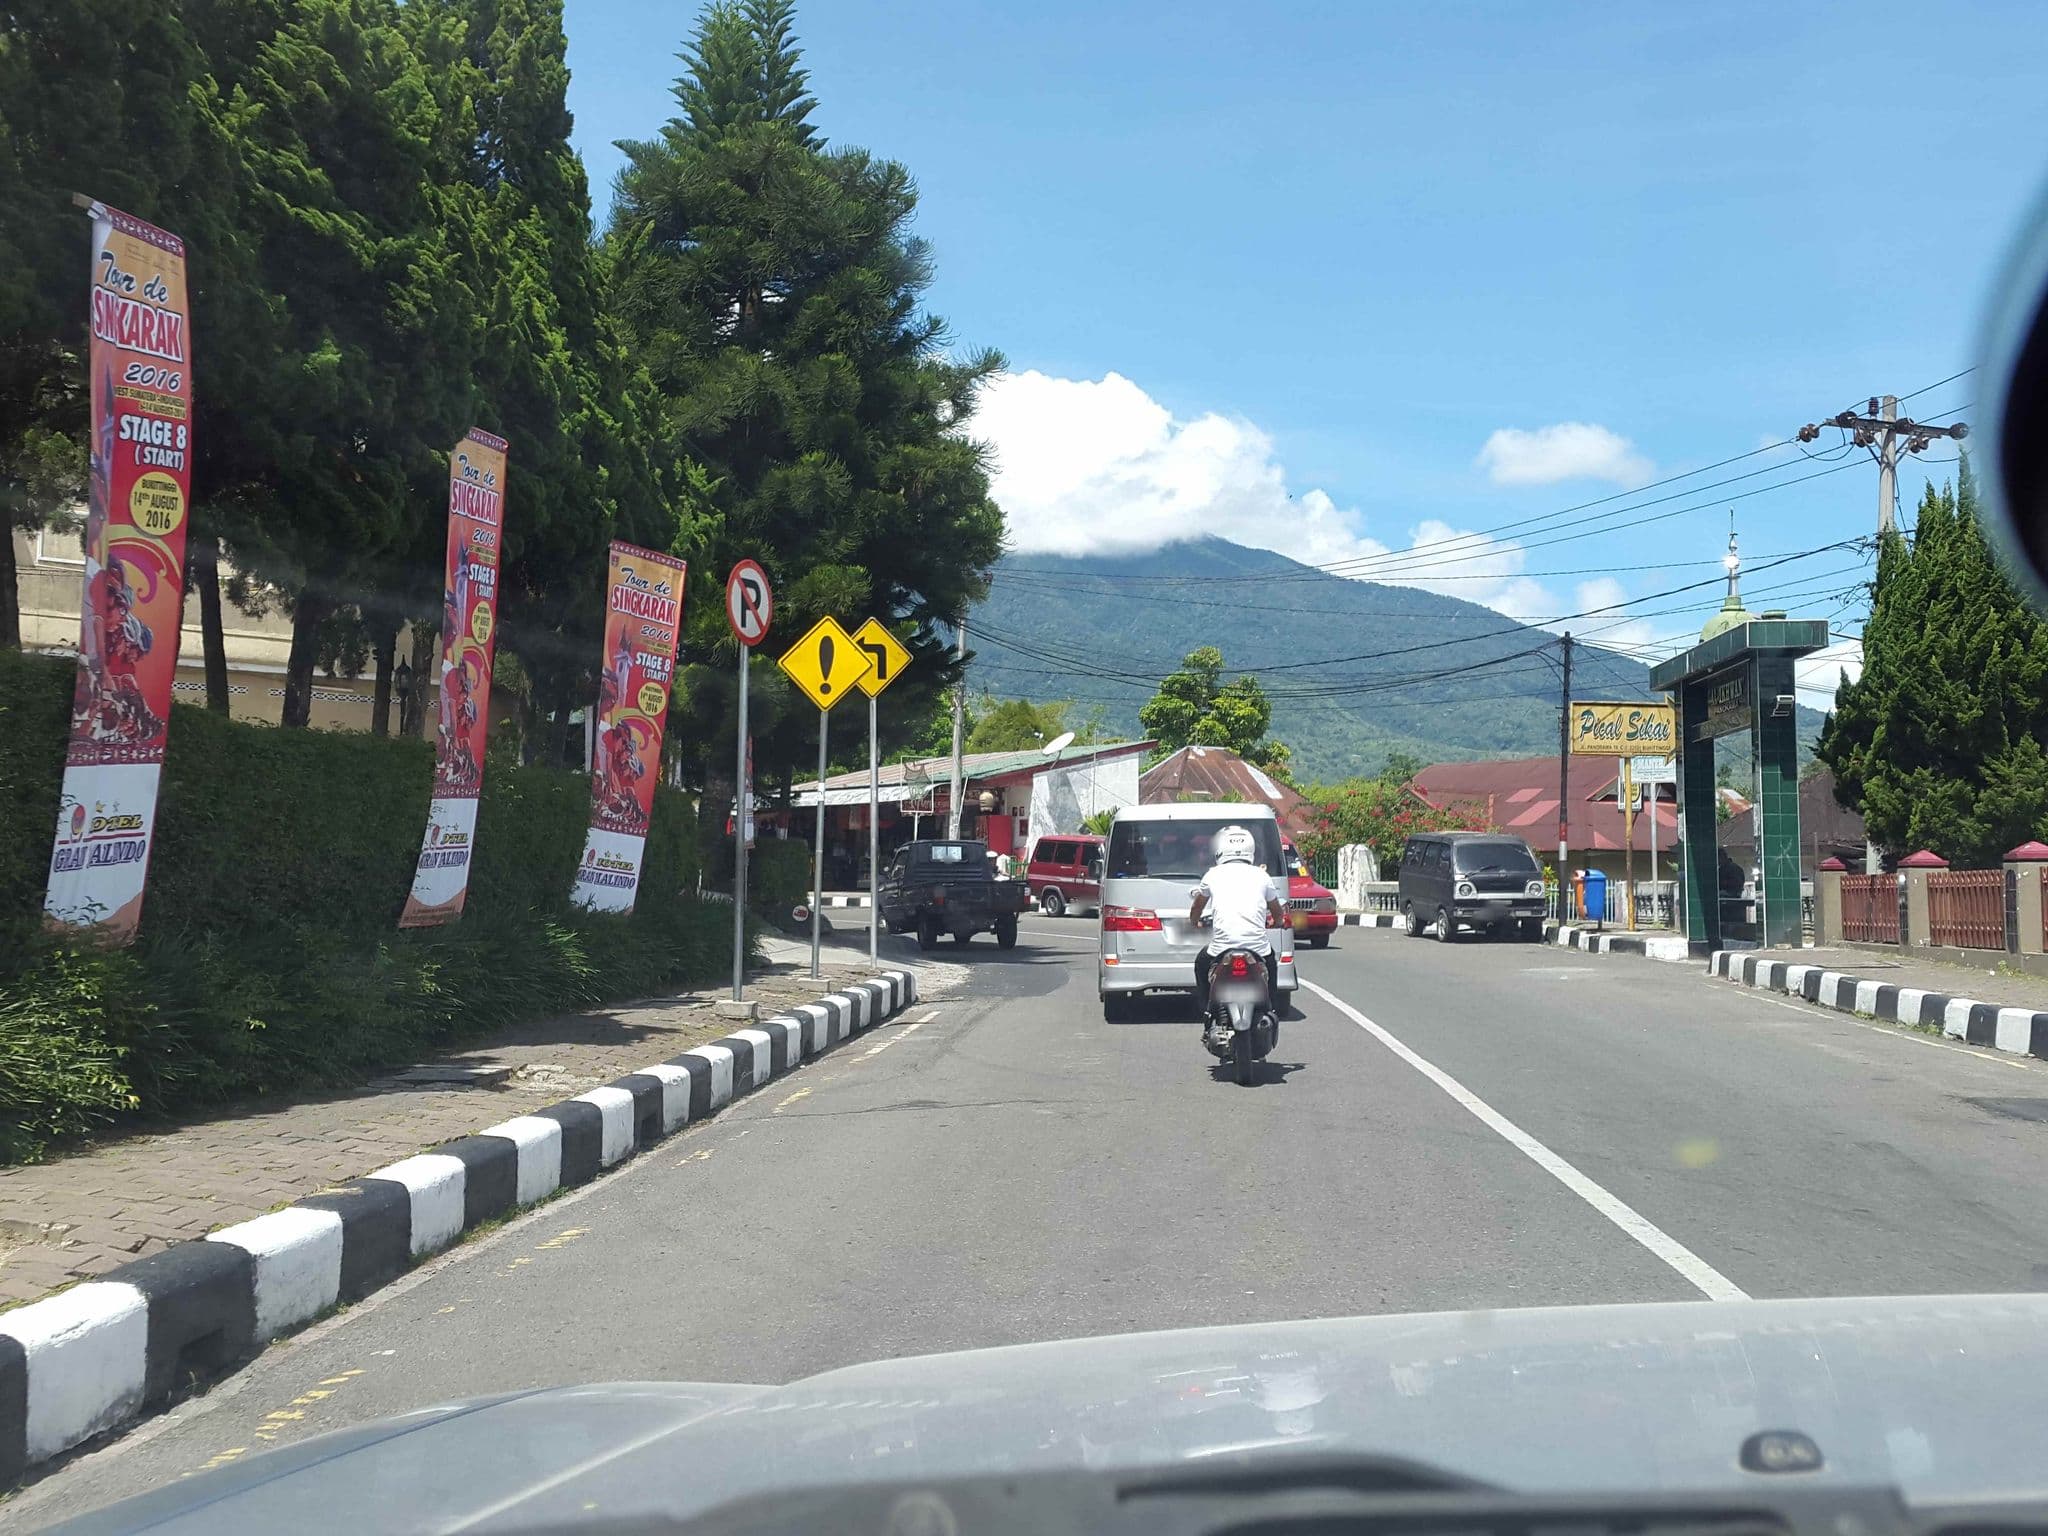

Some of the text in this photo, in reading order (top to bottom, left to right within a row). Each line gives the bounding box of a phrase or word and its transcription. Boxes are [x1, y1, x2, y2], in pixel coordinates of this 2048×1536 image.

[100, 250, 168, 304] Tour de
[123, 362, 182, 392] 2016
[118, 414, 187, 450] STAGE 8
[483, 467, 496, 486] de
[150, 493, 178, 511] AUGUST
[145, 509, 171, 530] 2016
[472, 527, 497, 547] 2016
[468, 563, 489, 585] STAGE
[621, 567, 671, 595] Tour de
[612, 585, 676, 627] SINGKARAK
[640, 625, 672, 641] 2016
[635, 652, 671, 673] STAGE 8
[1580, 709, 1623, 743] Pical
[1625, 710, 1671, 742] Sikai
